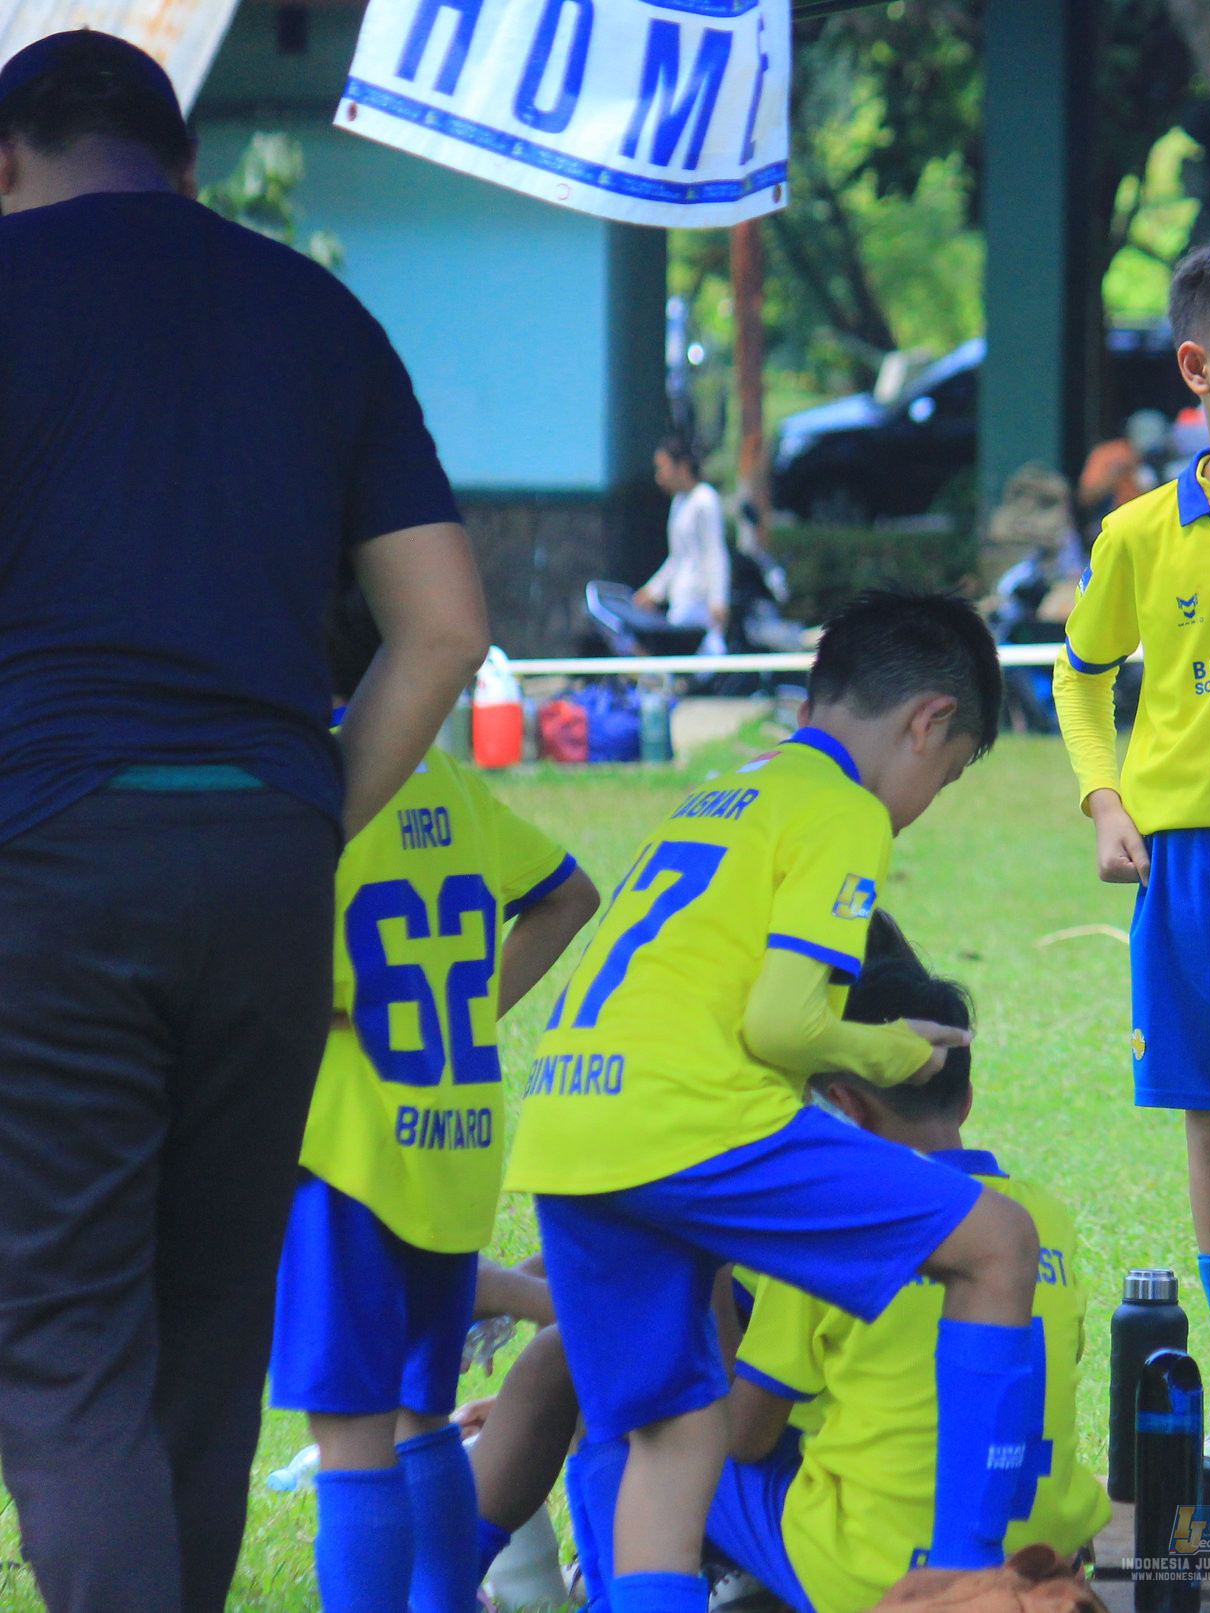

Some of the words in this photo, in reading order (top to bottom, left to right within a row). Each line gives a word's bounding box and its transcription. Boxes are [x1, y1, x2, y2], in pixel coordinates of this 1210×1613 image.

[670, 788, 760, 821] AGNAR
[398, 806, 452, 850] HIRO
[544, 840, 730, 1033] 7
[344, 873, 502, 1087] 62
[395, 1105, 492, 1150] BINTARO
